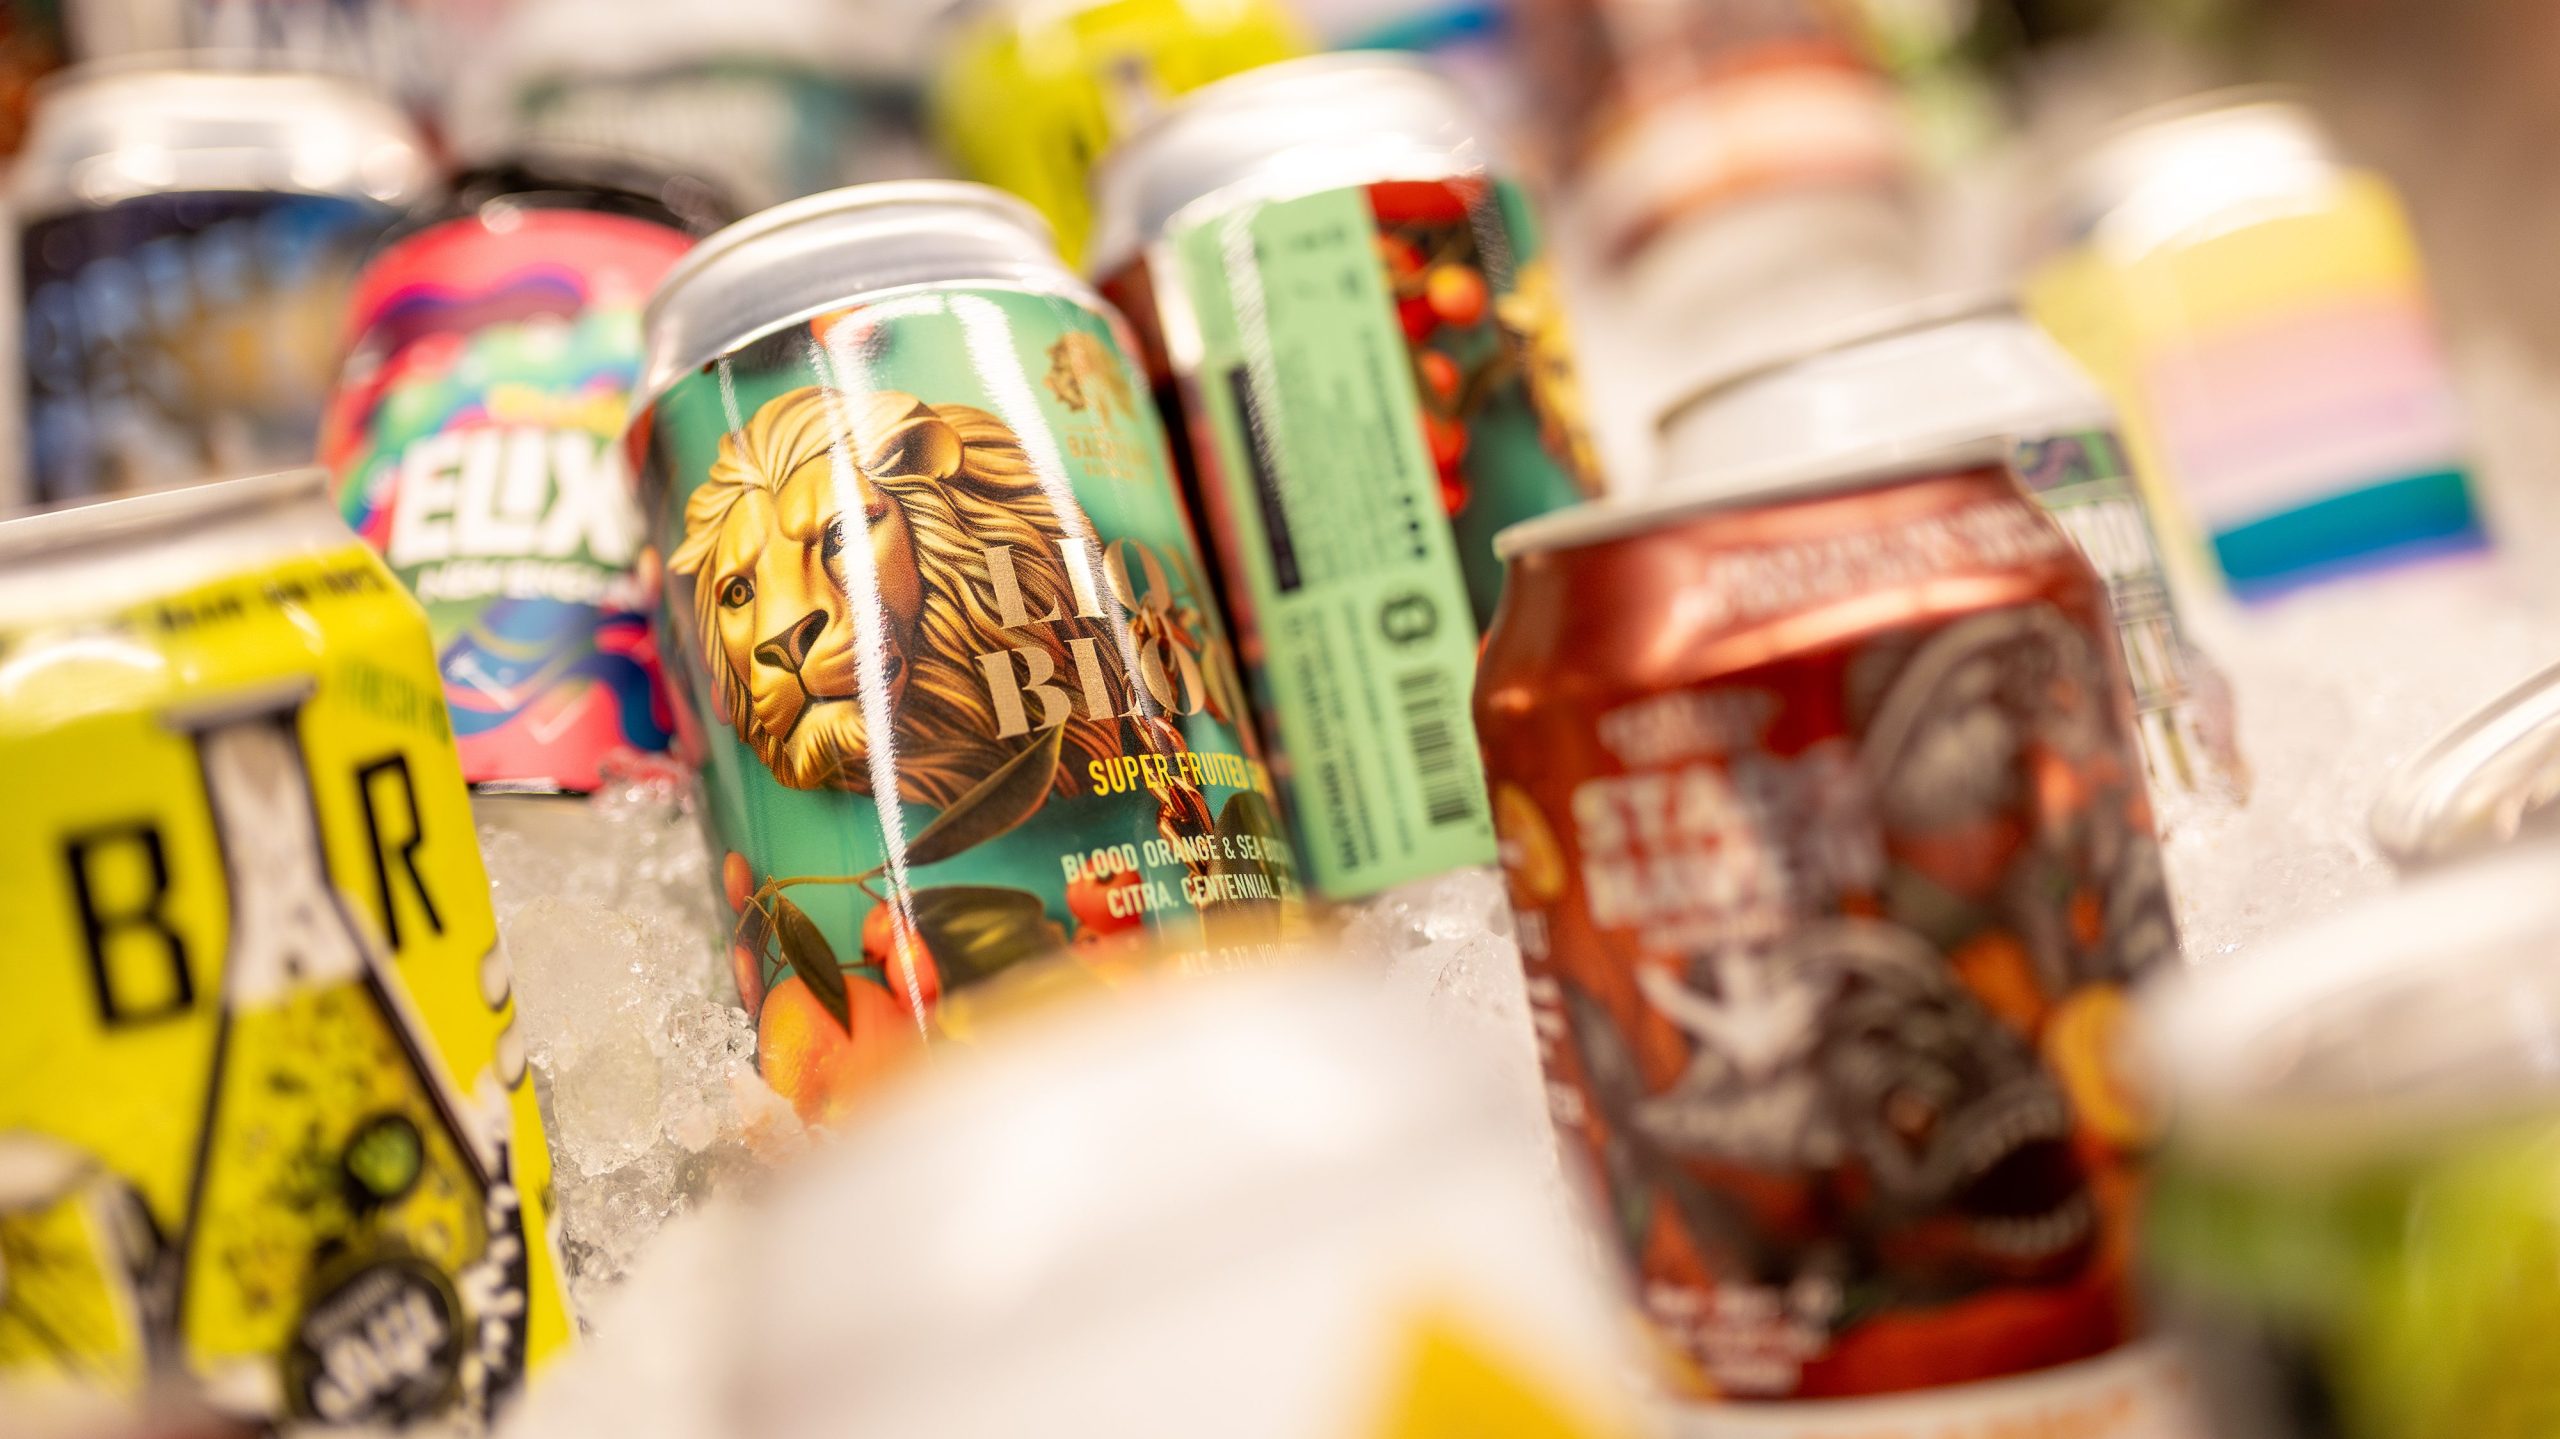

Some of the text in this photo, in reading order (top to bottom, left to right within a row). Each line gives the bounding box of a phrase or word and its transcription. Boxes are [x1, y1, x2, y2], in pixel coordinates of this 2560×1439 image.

[1088, 752, 1174, 797] SUPER
[1175, 751, 1250, 790] FRUITED
[1060, 842, 1141, 884] BLOOD
[1142, 834, 1221, 869] ORANGE
[1222, 836, 1237, 860] &
[1236, 834, 1265, 861] SEA
